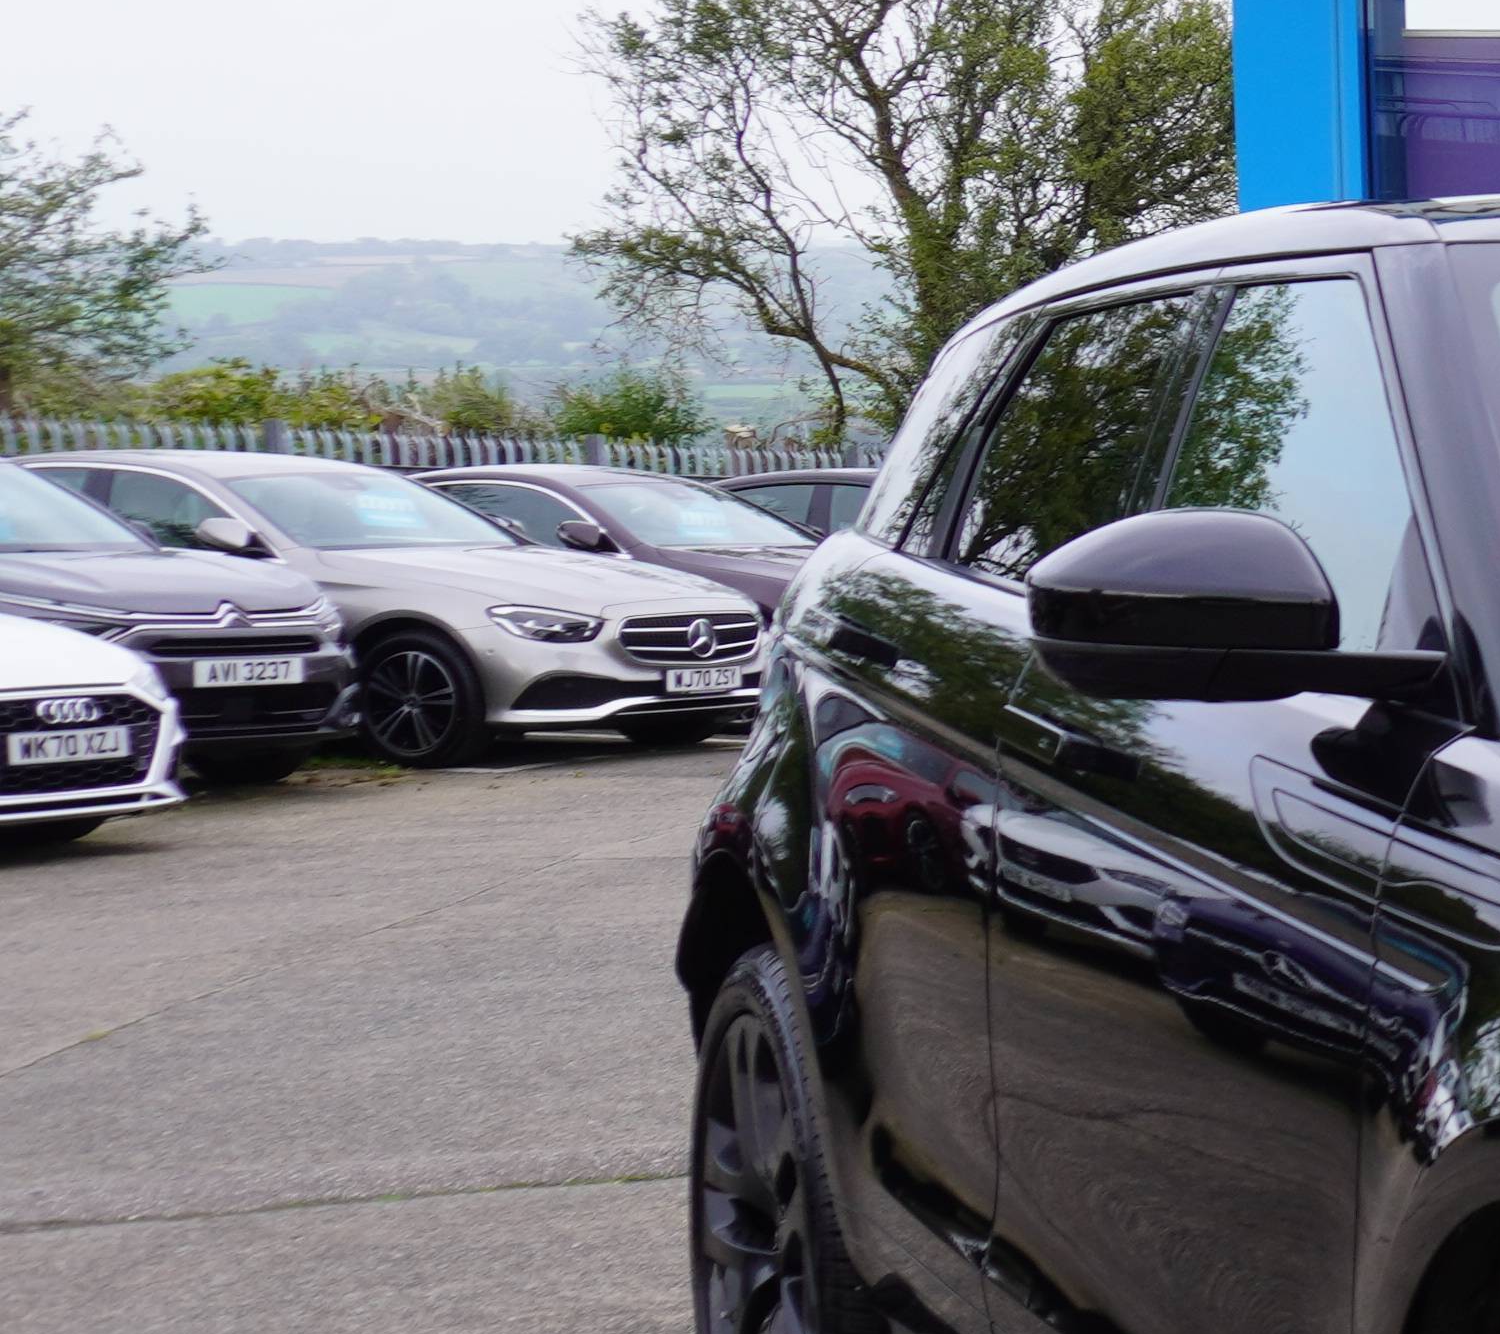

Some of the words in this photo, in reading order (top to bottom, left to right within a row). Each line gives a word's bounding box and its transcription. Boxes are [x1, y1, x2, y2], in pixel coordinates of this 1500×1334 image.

[207, 663, 237, 683] AVI
[243, 661, 291, 682] 3237
[20, 735, 78, 759] WK70
[84, 731, 120, 755] XZJ
